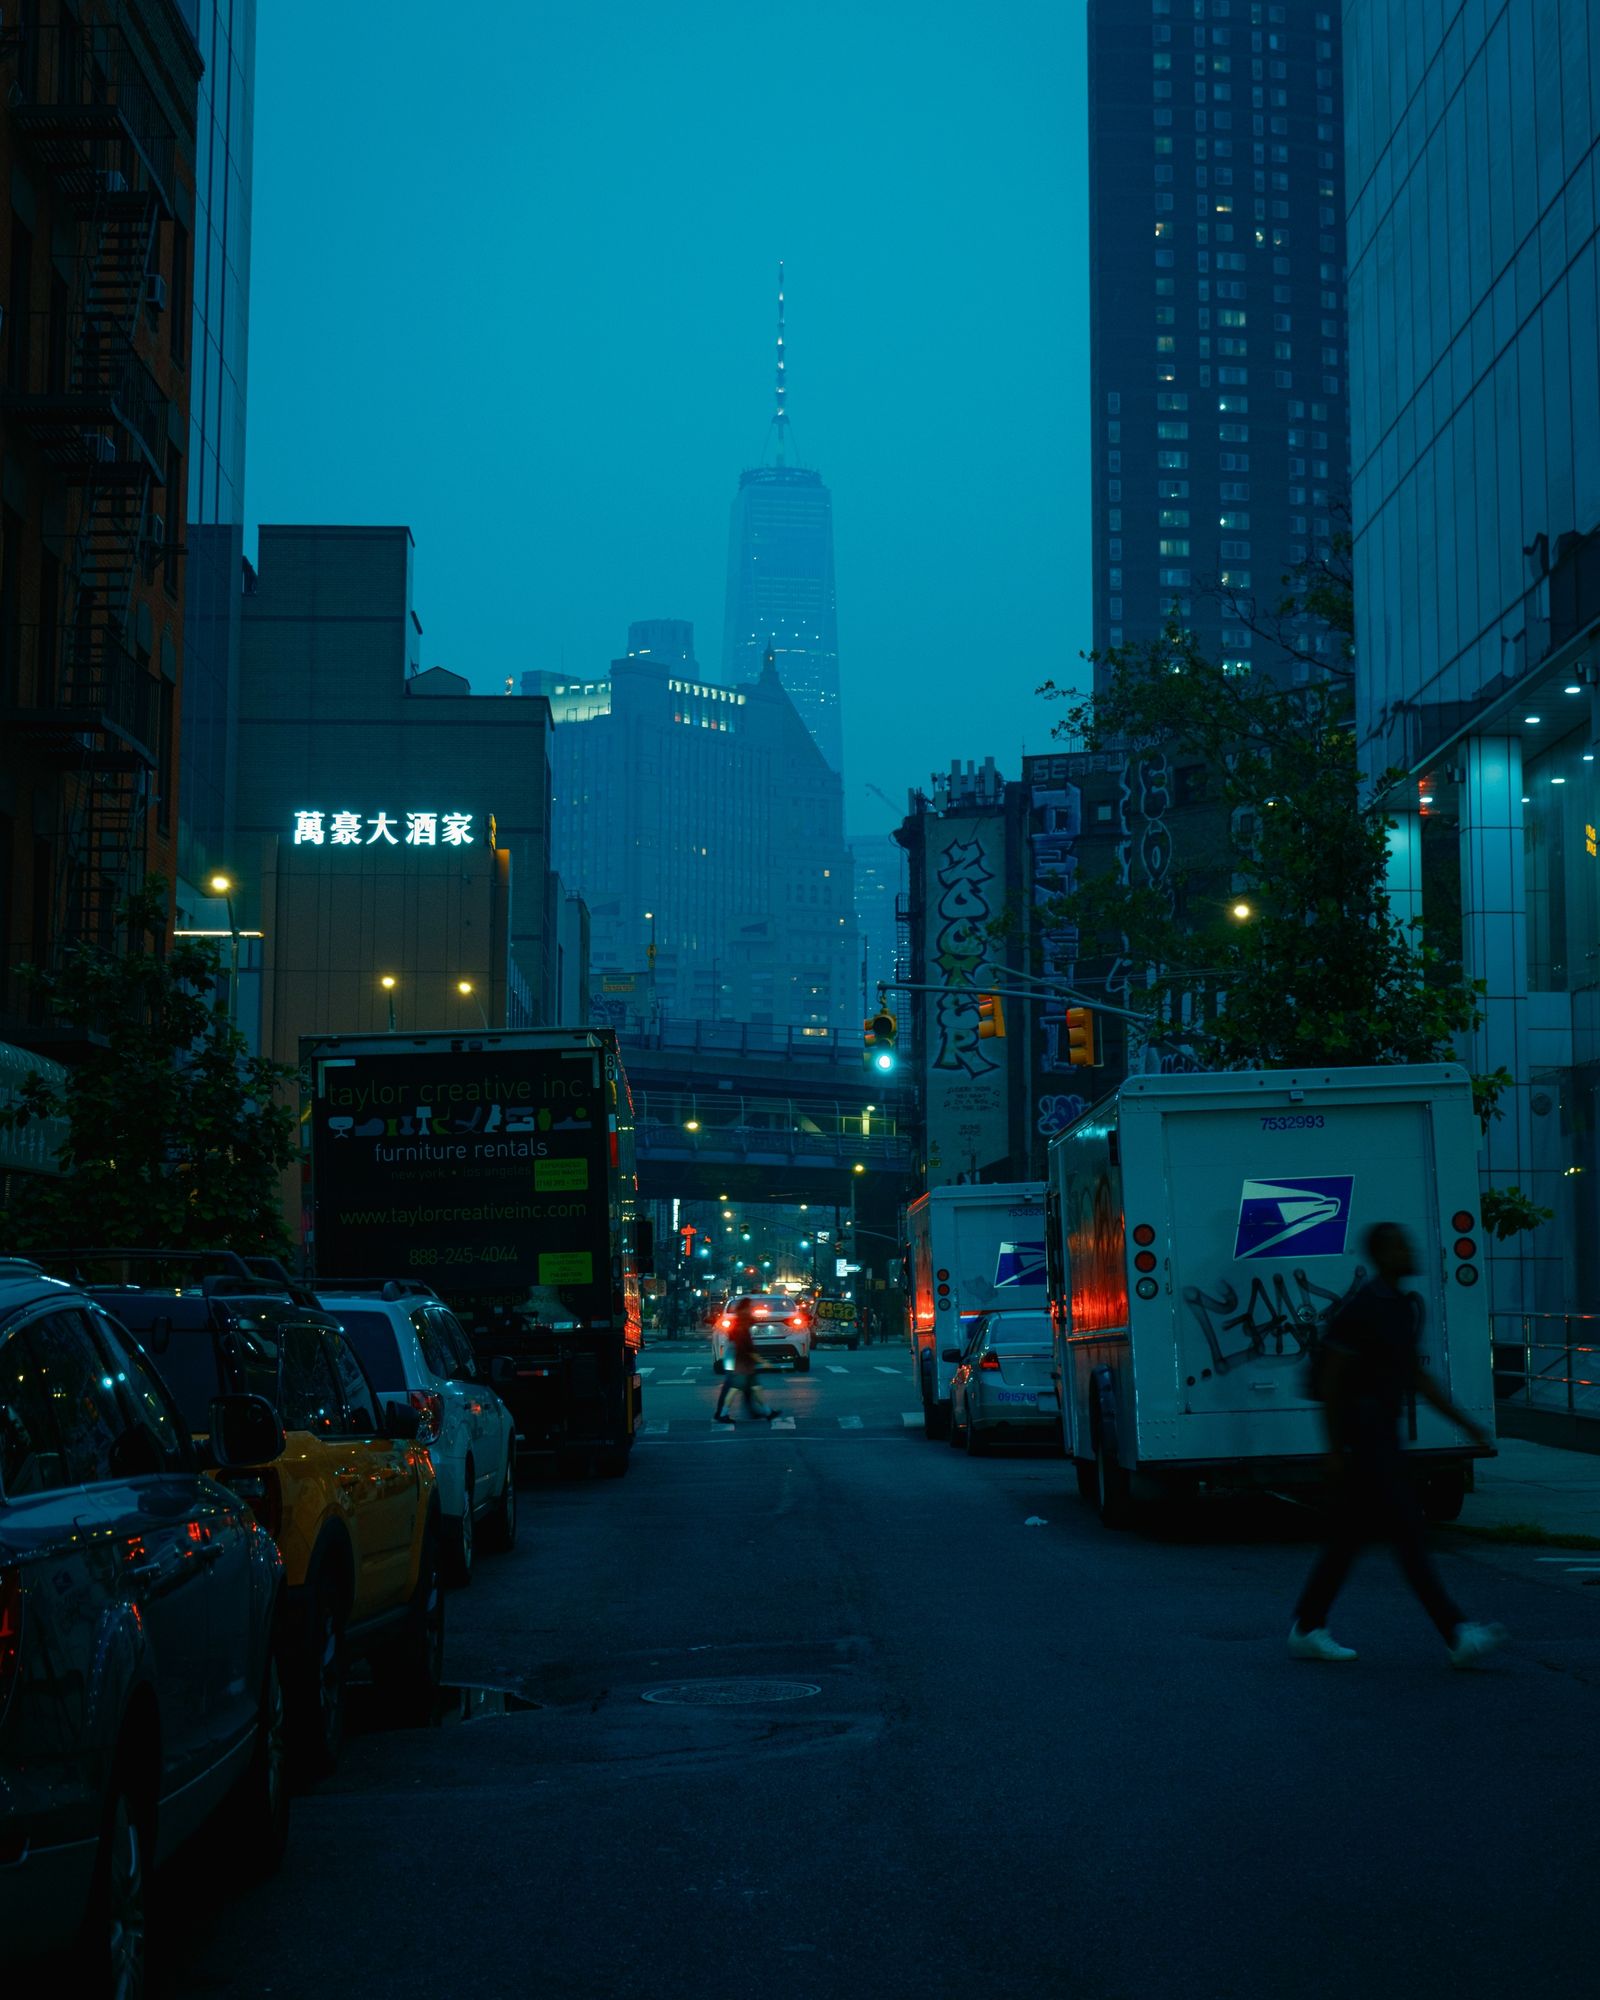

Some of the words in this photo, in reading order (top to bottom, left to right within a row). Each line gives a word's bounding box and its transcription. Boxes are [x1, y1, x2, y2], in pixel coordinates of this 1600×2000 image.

[293, 809, 474, 846] 萬豪大酒家
[328, 1081, 410, 1111] taylor
[420, 1075, 532, 1104] creative
[543, 1073, 592, 1098] inc.
[1261, 1114, 1325, 1131] 7532993
[374, 1141, 466, 1163] furniture
[473, 1138, 548, 1160] rentals
[339, 1202, 586, 1226] www.taylorcreativeinc.com
[409, 1247, 518, 1266] 888-245-4044
